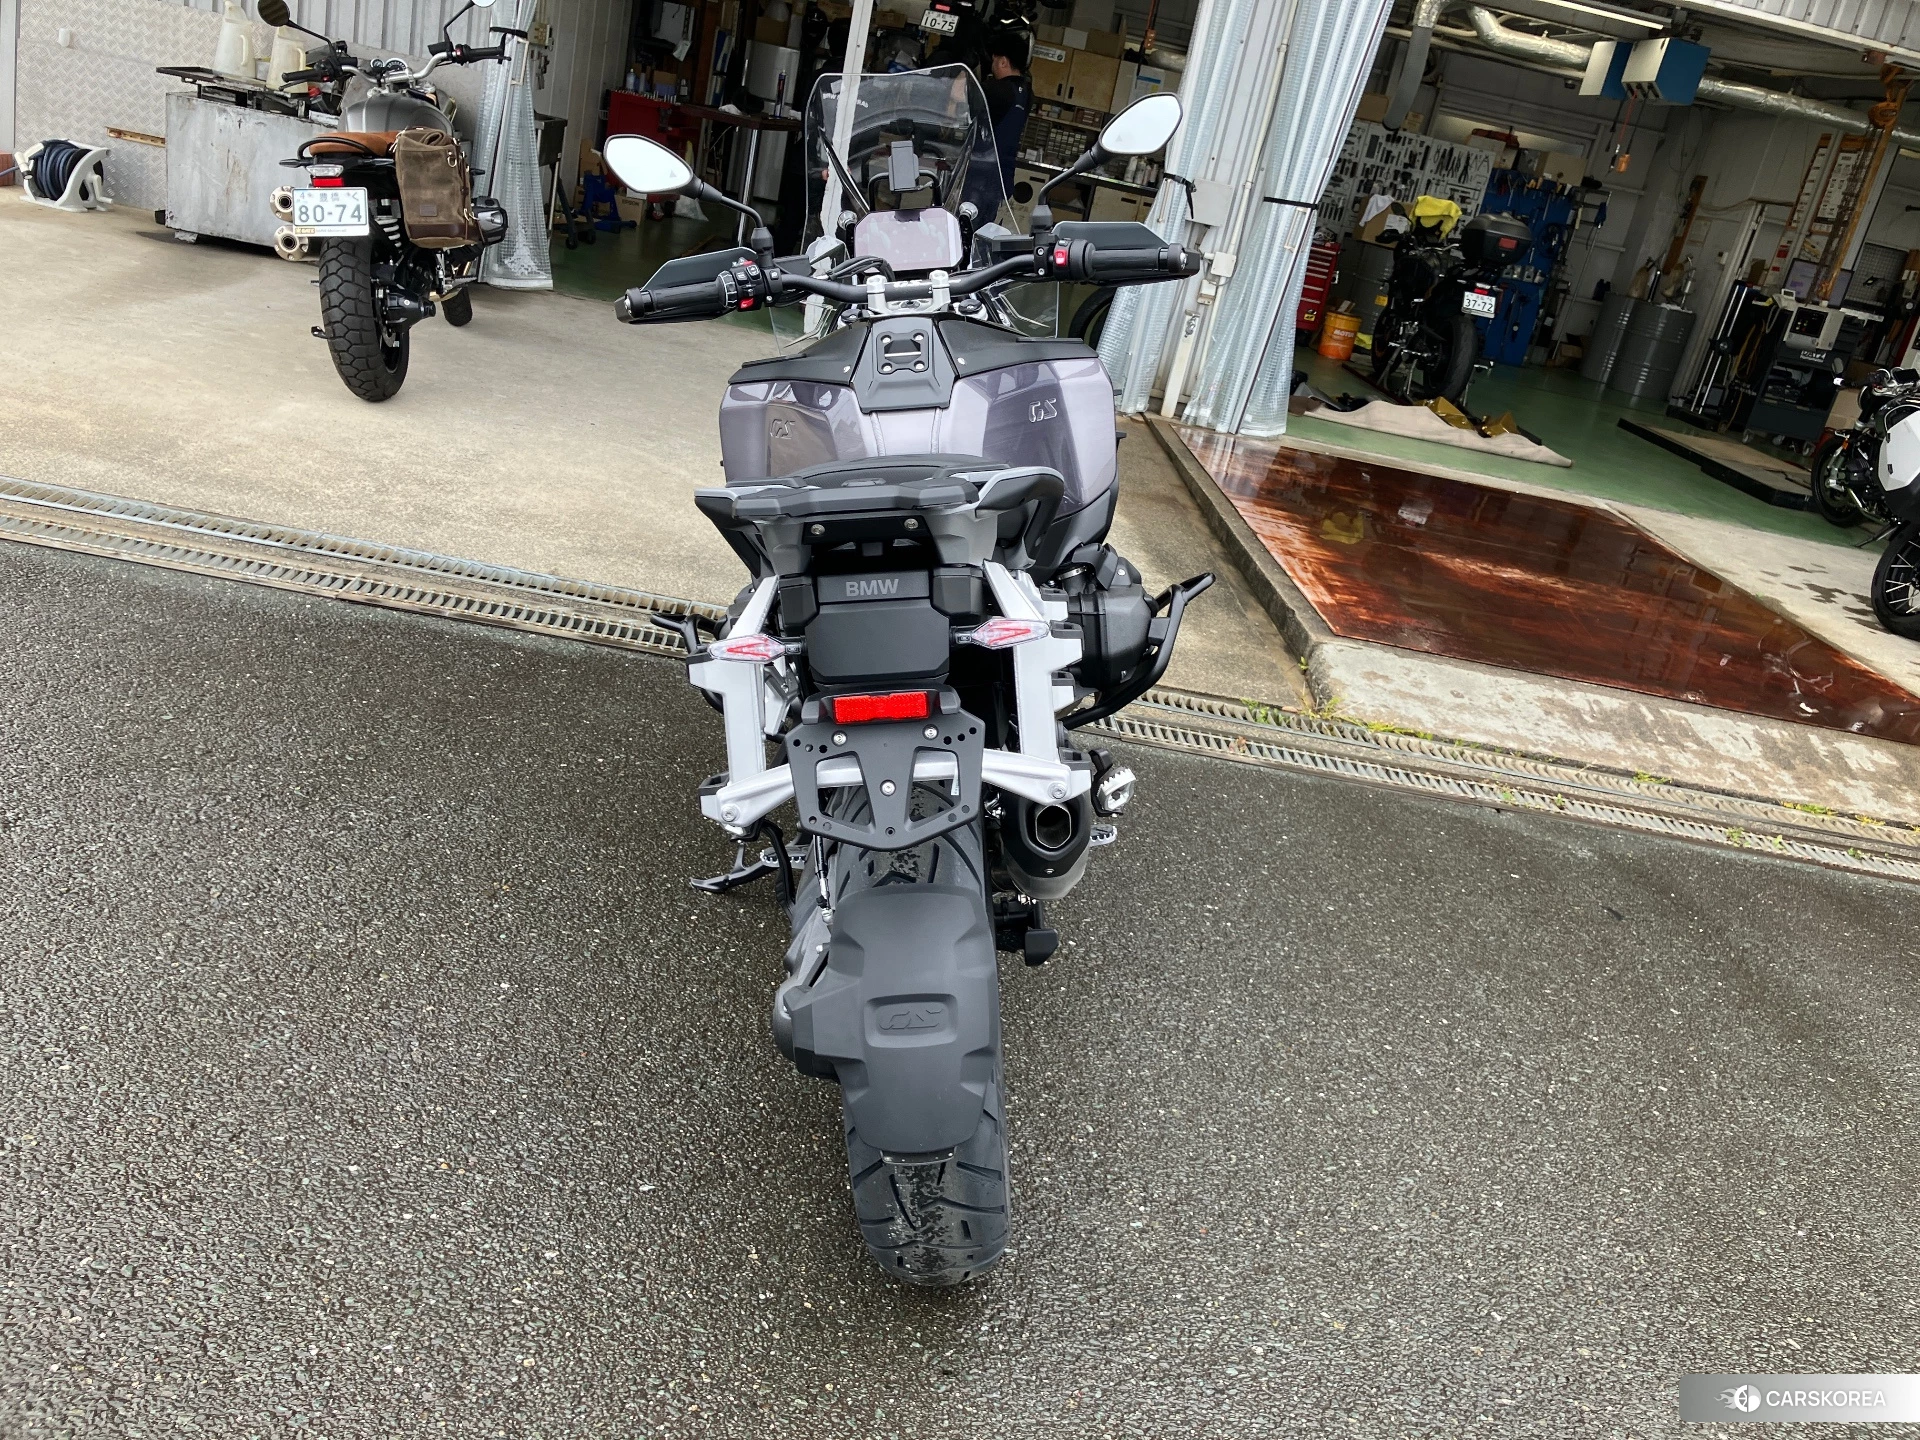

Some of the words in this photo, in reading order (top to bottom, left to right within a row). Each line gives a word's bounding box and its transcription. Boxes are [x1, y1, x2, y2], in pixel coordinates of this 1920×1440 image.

[924, 16, 955, 30] 10-75
[299, 204, 362, 222] 80-74
[1465, 298, 1494, 312] 37-72
[1028, 398, 1058, 423] GS
[770, 418, 796, 440] GS
[846, 578, 899, 596] BMW
